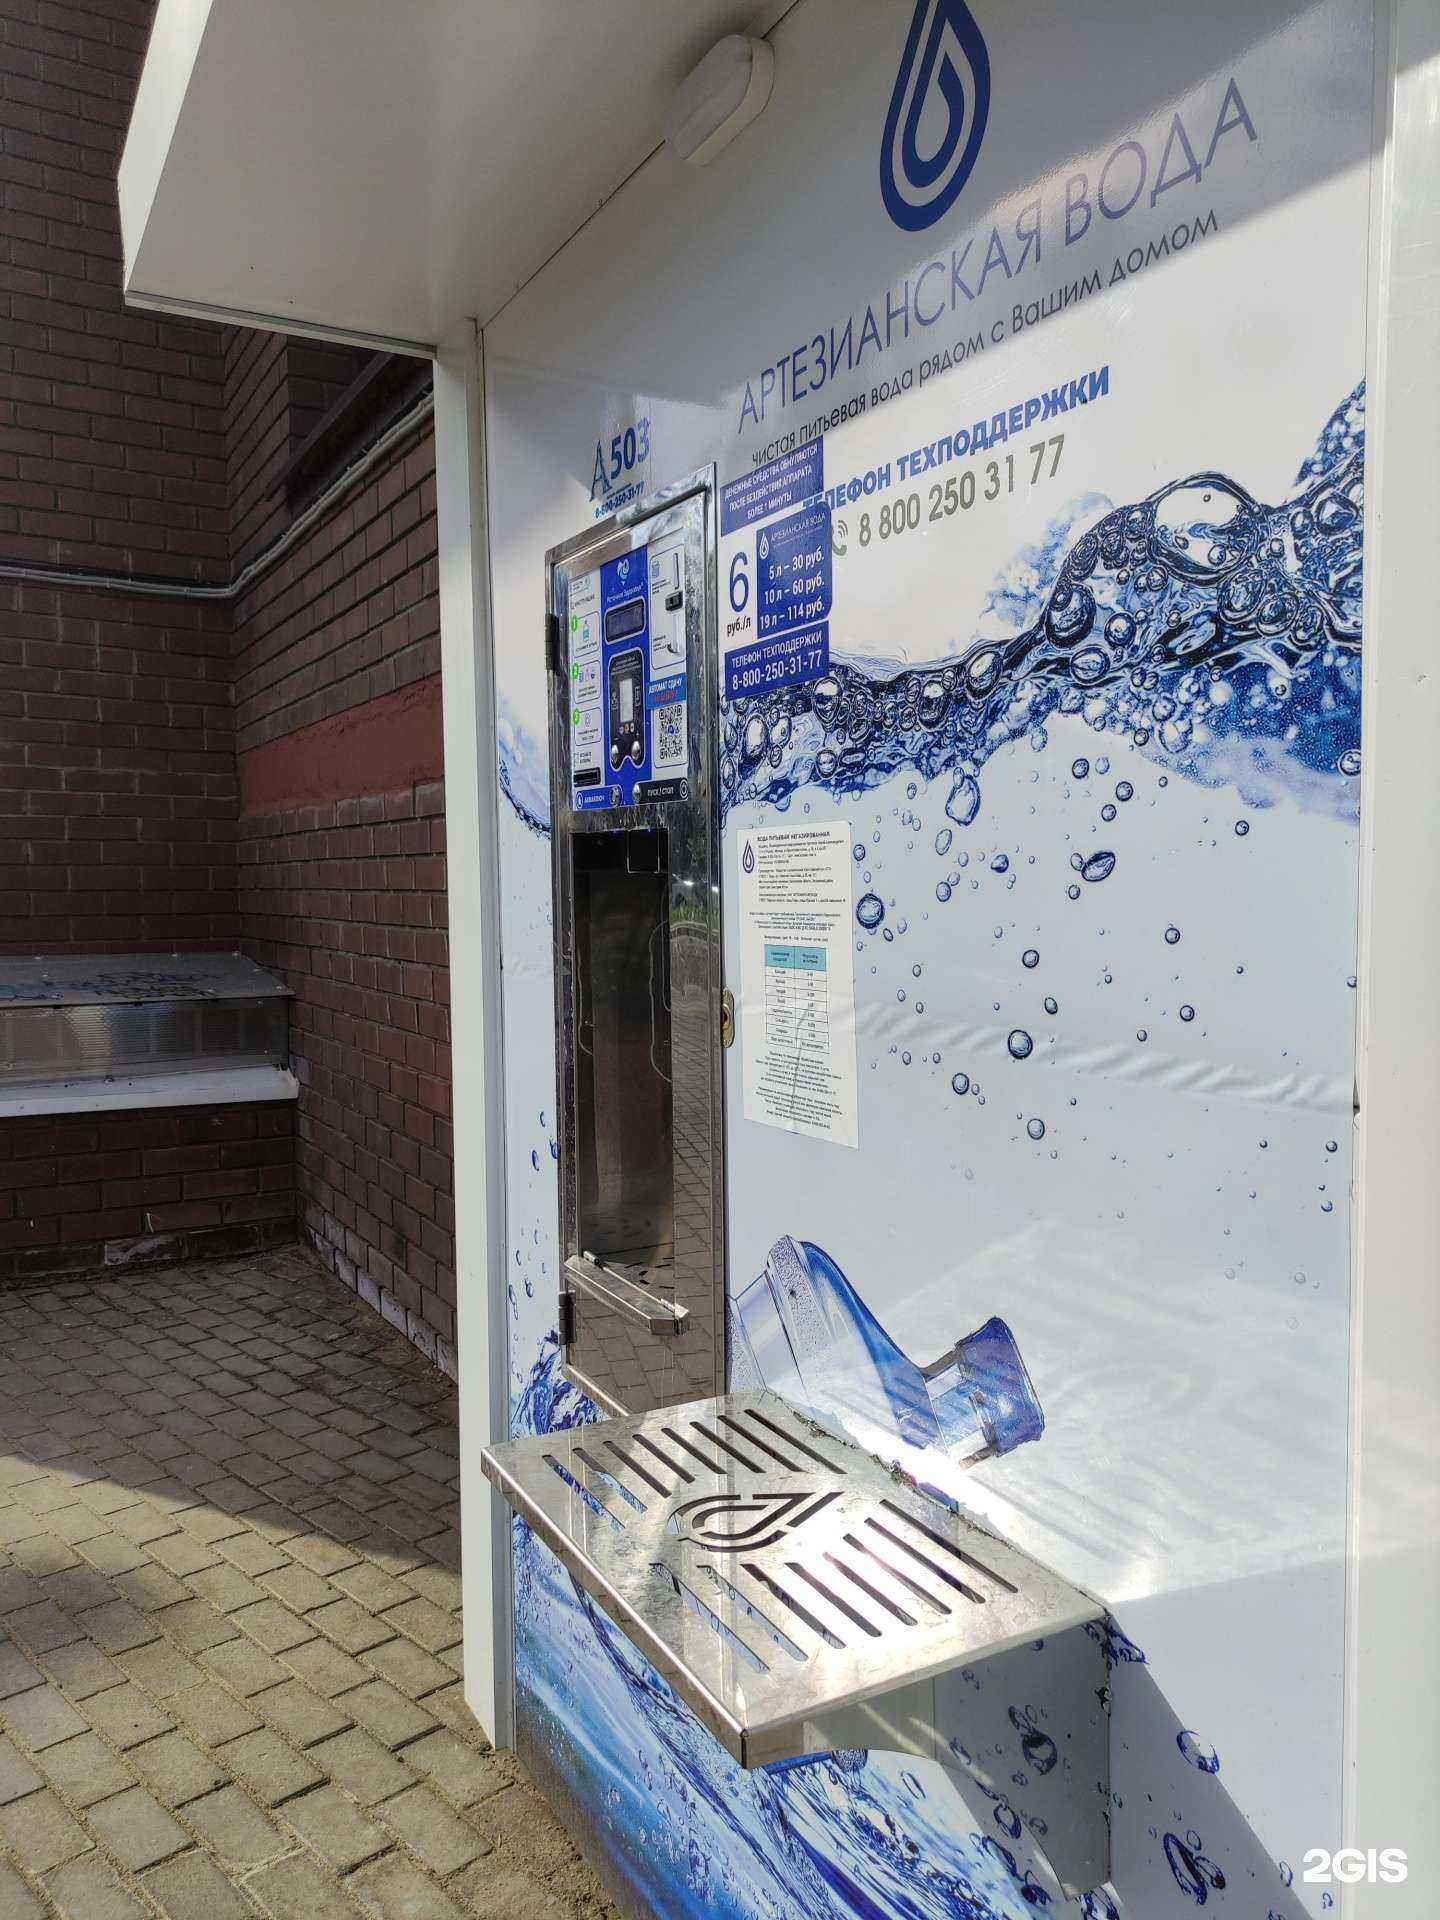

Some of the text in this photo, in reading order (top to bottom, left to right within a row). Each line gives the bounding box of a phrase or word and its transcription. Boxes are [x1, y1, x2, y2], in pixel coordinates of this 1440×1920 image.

[737, 78, 1258, 434] АРТЕЗИАНСКАЯ ВОДА
[752, 210, 1219, 467] чистая питьевая вода рядом с Вашим домом
[802, 364, 1110, 511] ЛЕФОН ТЕХПОДДЕРЖКИ
[858, 513, 871, 547] 8
[878, 493, 921, 541] 800
[928, 471, 976, 522] 250
[984, 454, 1014, 500] 31
[1029, 433, 1065, 485] 77
[729, 551, 749, 613] 6
[769, 565, 775, 580] 5
[776, 564, 782, 576] л
[792, 554, 804, 571] 30
[805, 545, 825, 571] руб.
[765, 589, 775, 605] 10
[776, 588, 782, 600] л
[792, 578, 804, 596] 60
[805, 570, 825, 594] руб.
[726, 615, 751, 638] руб./л
[760, 615, 770, 630] 19
[771, 614, 778, 627] л
[787, 602, 804, 621] 114
[805, 595, 825, 618] руб.
[731, 630, 822, 669] ТЕЛЕФОН ТЕХПОДДЕРЖКИ
[732, 649, 822, 691] 8-800-250-31-77
